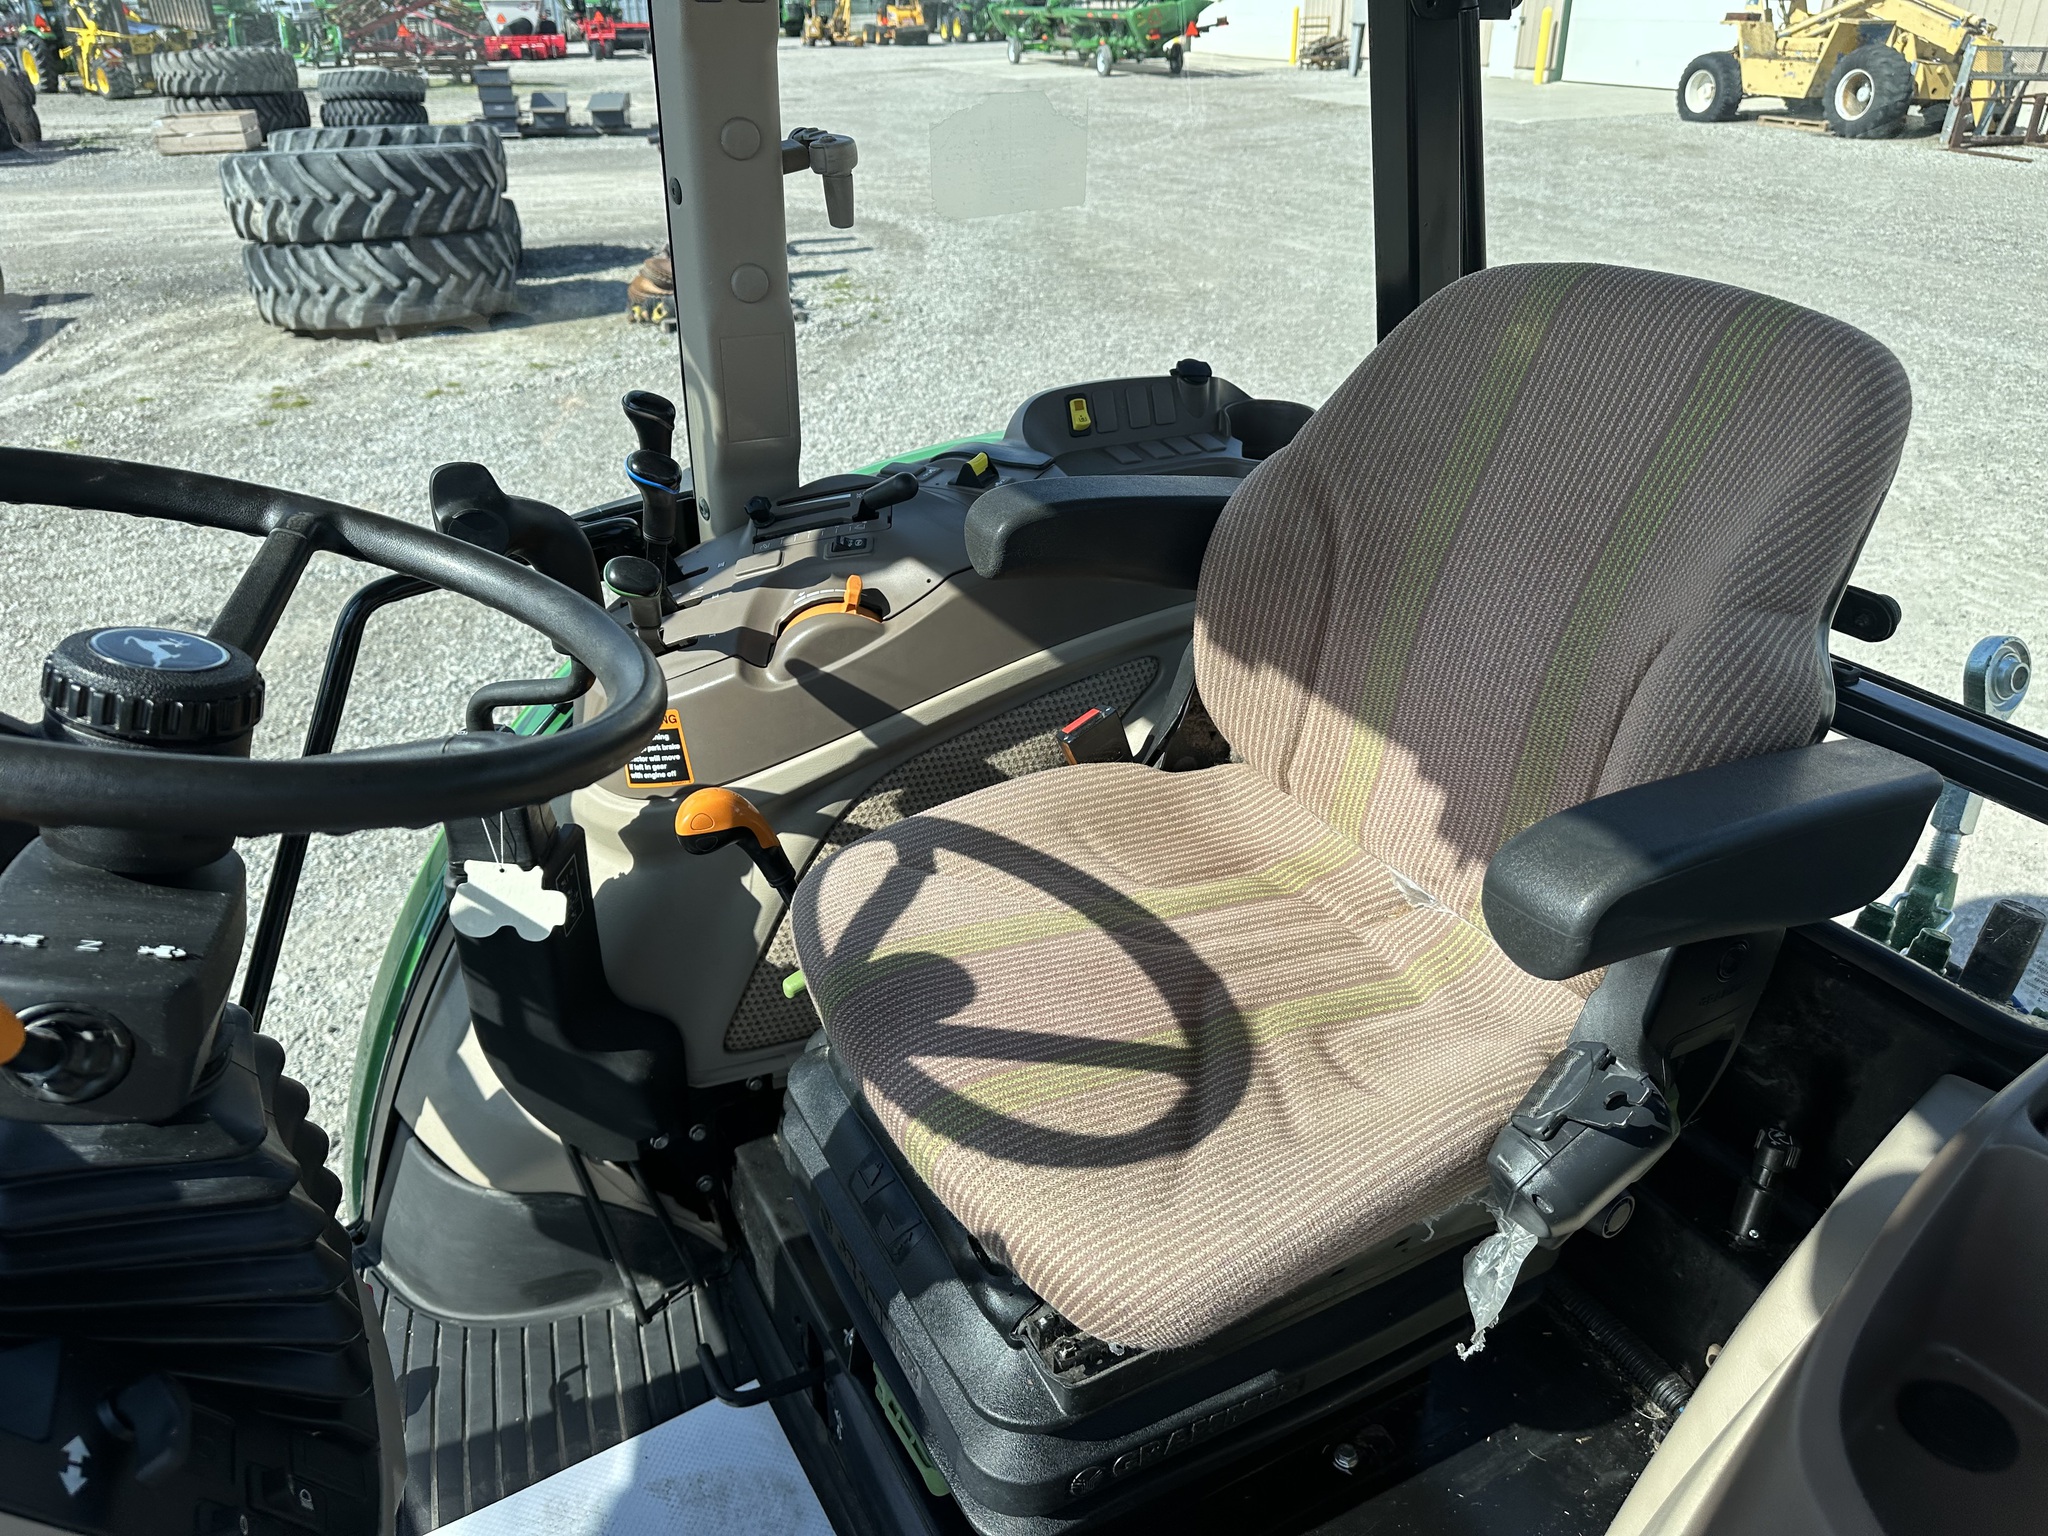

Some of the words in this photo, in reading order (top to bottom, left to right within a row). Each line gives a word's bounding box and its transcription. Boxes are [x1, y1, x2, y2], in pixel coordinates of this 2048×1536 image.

[647, 744, 661, 753] park
[652, 763, 667, 771] gear
[644, 771, 666, 780] engine
